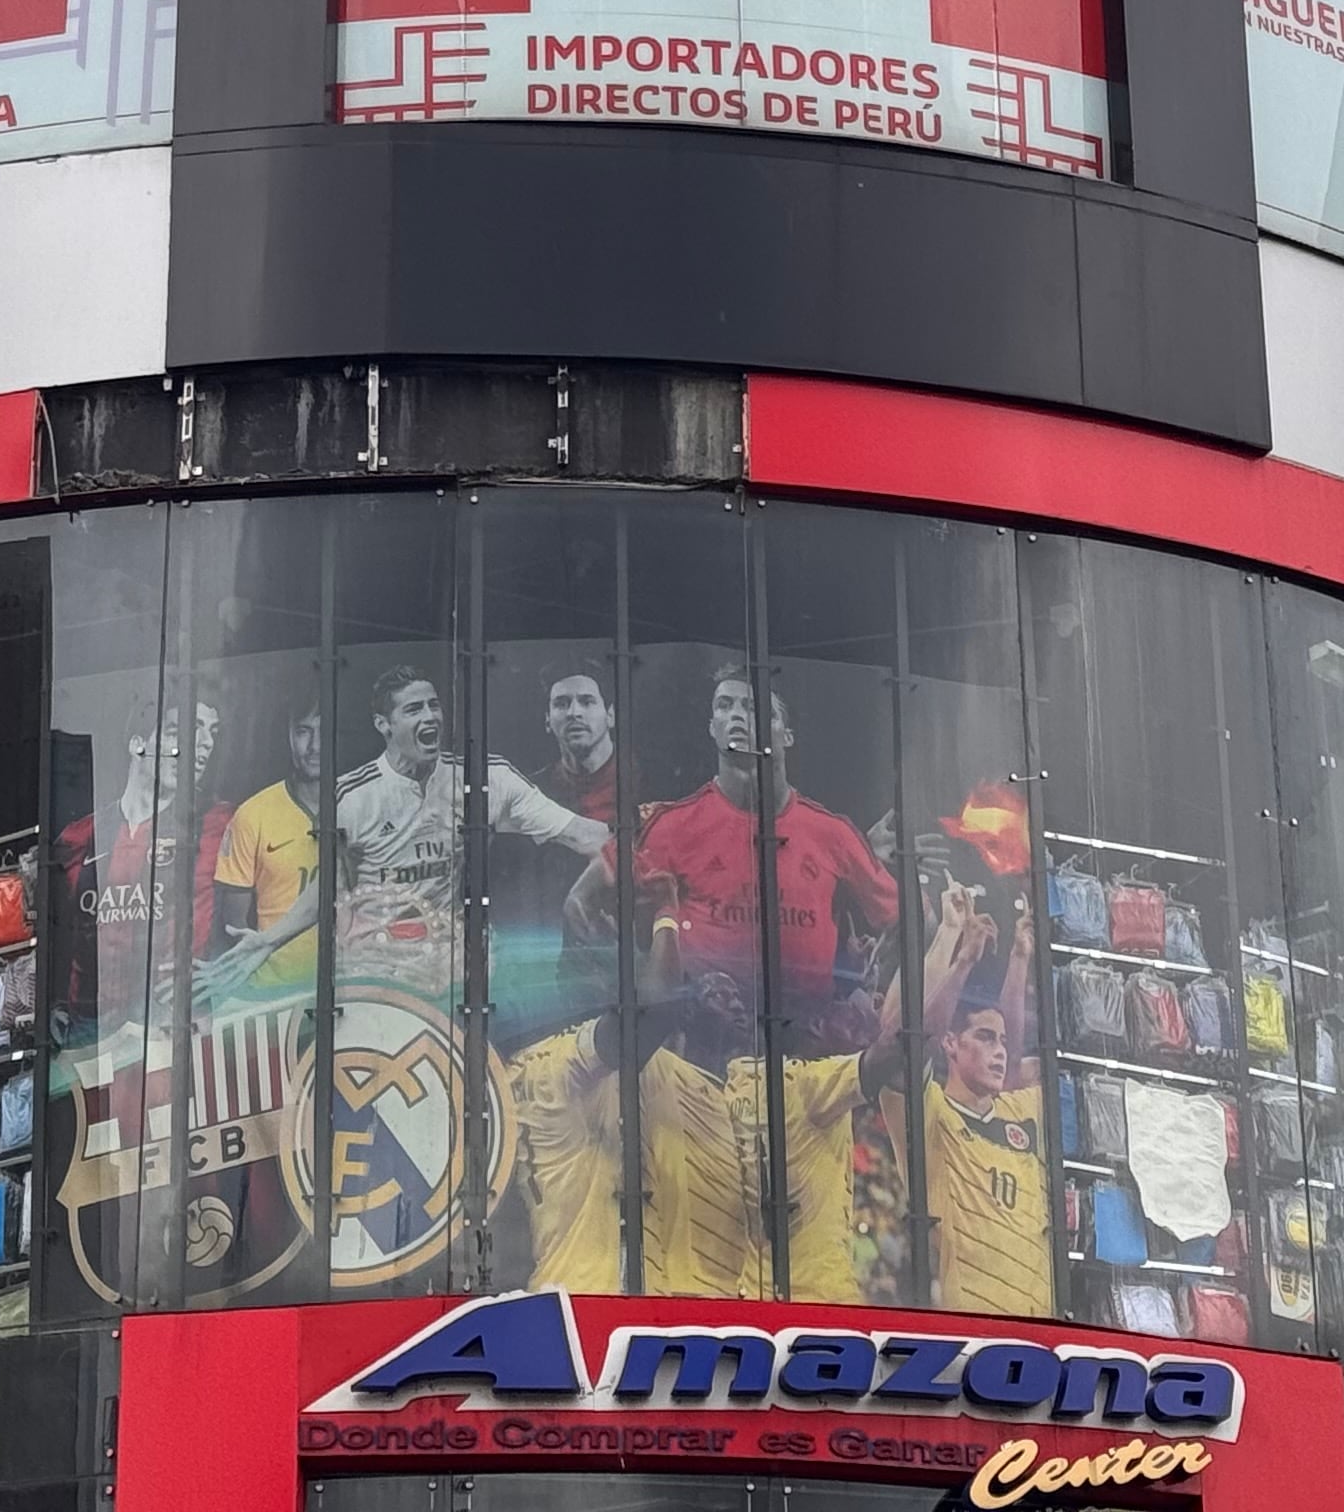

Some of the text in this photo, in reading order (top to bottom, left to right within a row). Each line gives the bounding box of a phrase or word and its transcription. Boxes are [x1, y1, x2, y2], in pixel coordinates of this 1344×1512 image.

[526, 34, 942, 100] IMPORTADORES
[526, 83, 944, 144] DIRECTOS DE PERÚ
[79, 883, 165, 915] QATAR
[95, 906, 164, 925] AIRWAYS
[991, 1166, 1017, 1211] 10
[346, 1290, 1238, 1426] Amazona
[299, 1417, 990, 1469] Donde Comprar es Ganar
[968, 1438, 1214, 1511] Center
